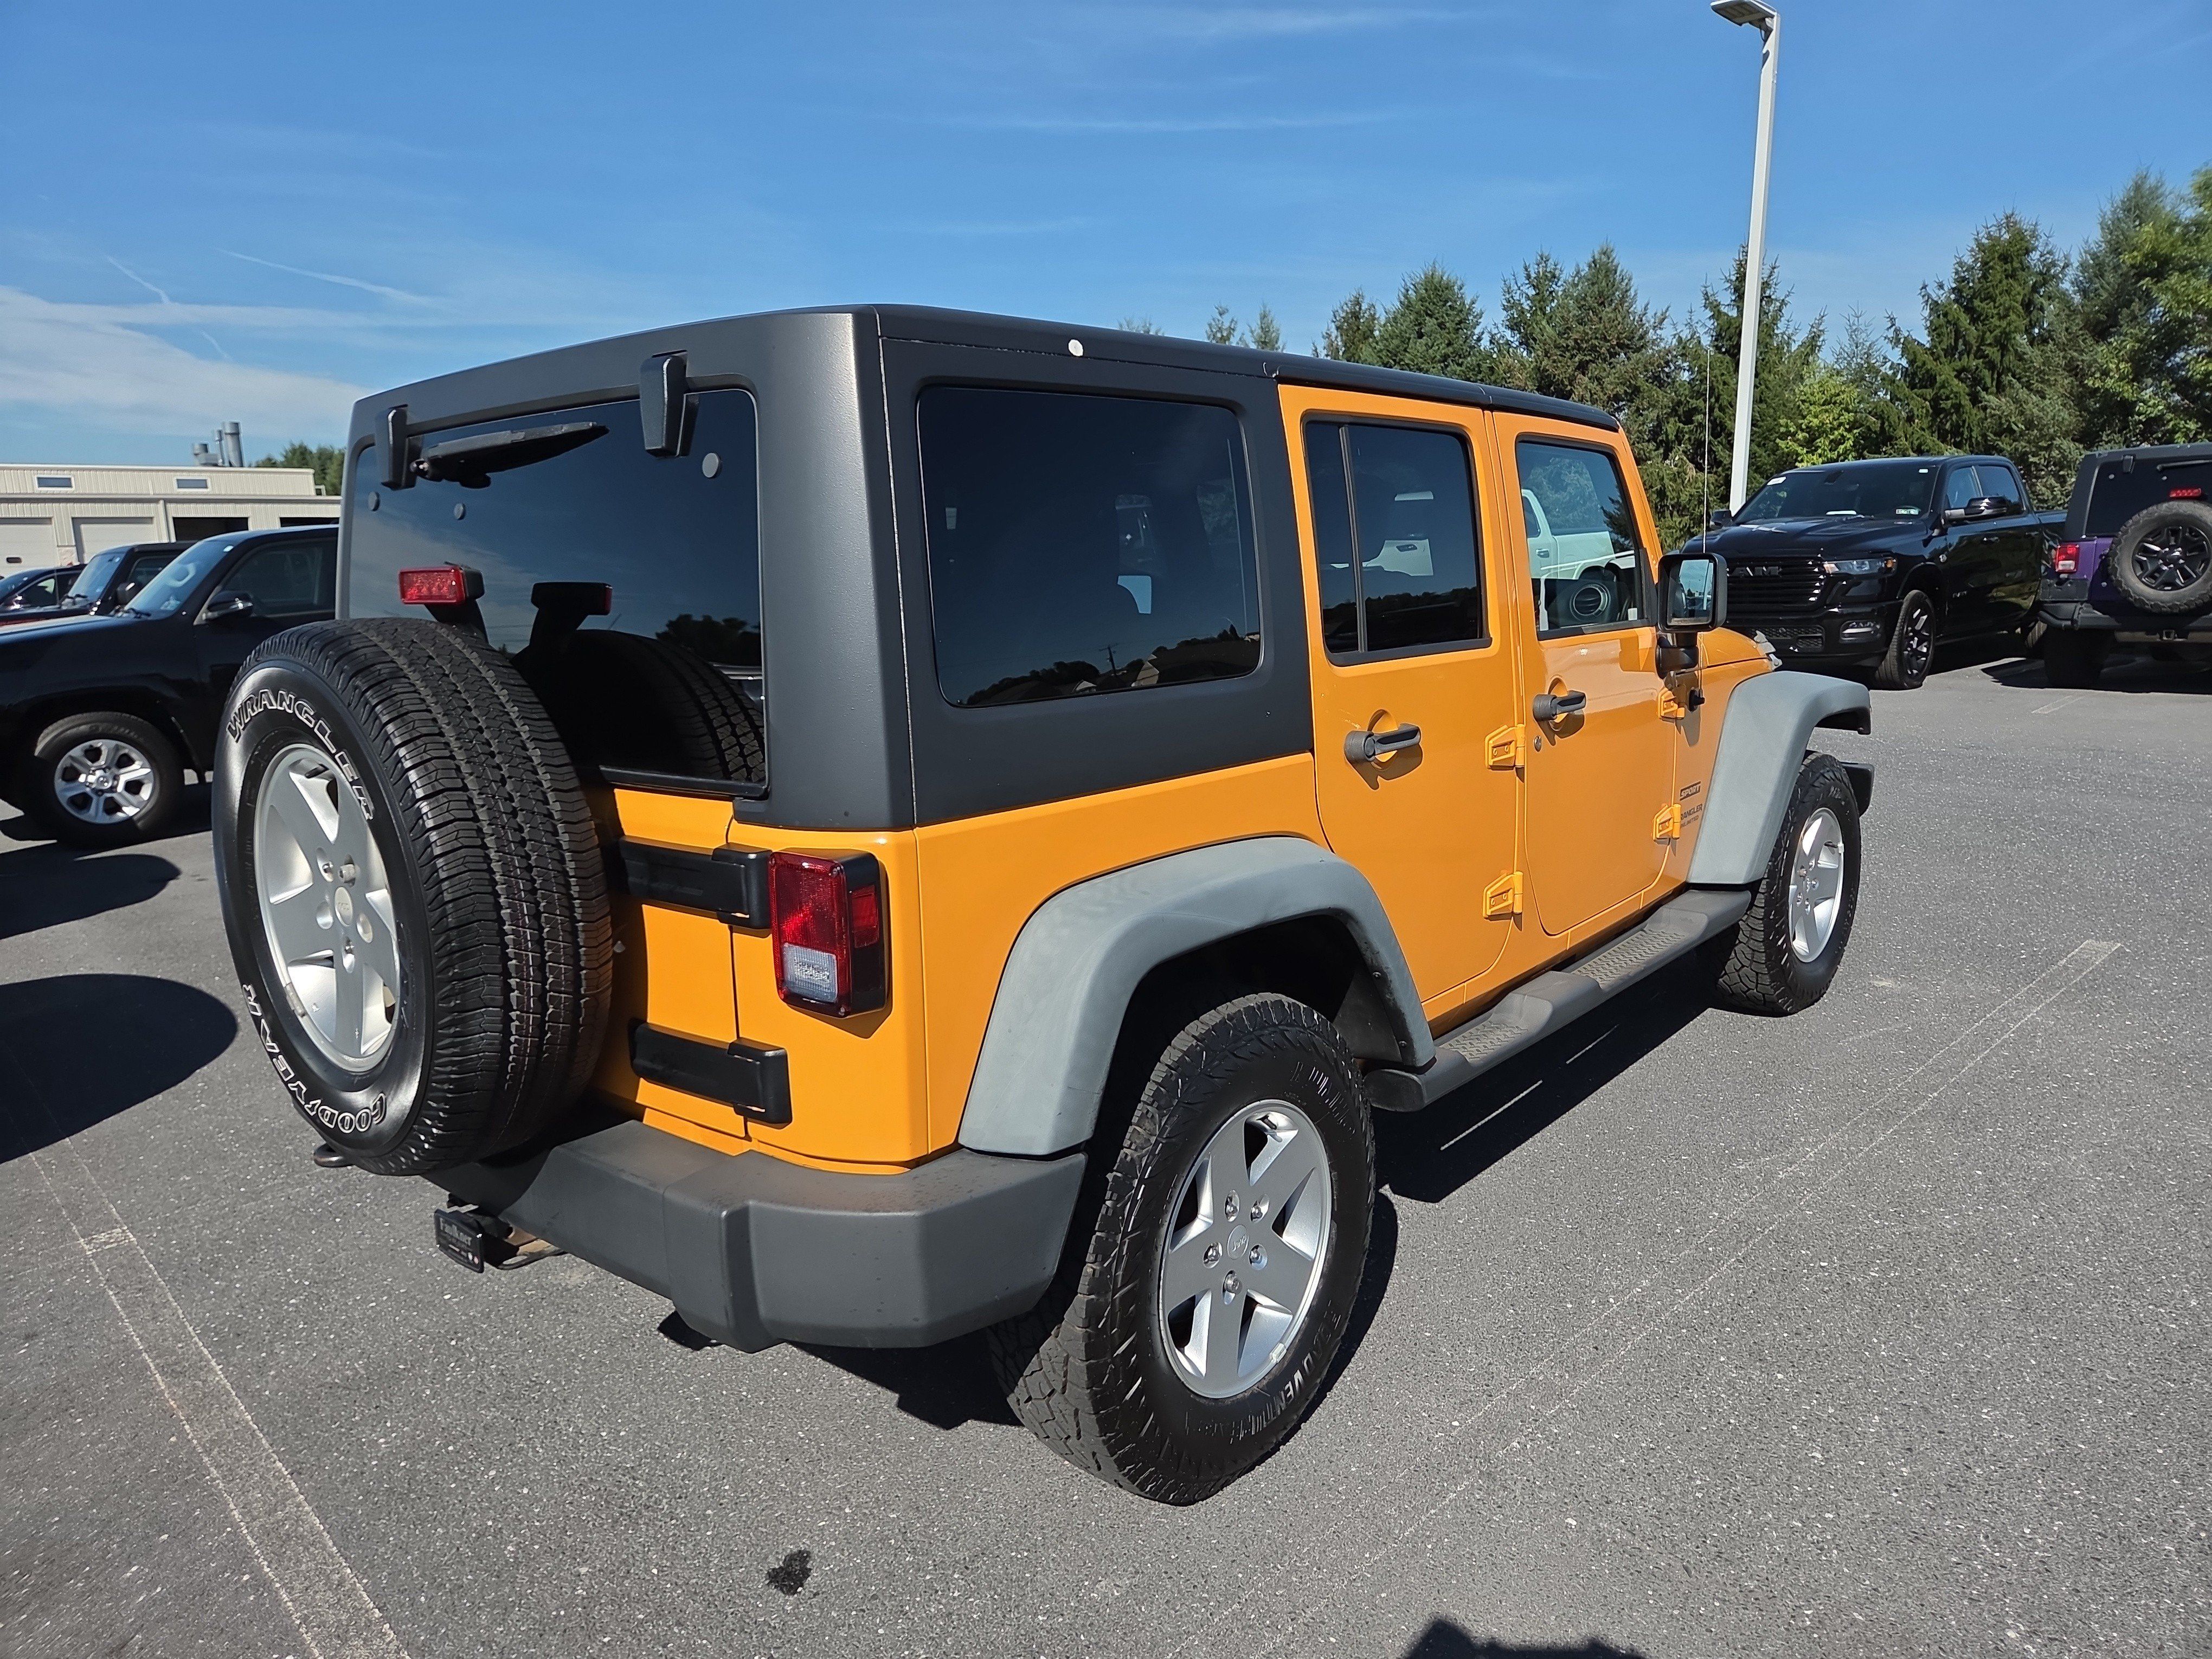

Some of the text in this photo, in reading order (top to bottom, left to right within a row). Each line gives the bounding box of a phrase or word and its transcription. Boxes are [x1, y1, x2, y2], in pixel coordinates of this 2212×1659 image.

[1729, 566, 1780, 577] AM
[226, 689, 375, 820] WRANGLER
[1680, 782, 1701, 799] SPORT
[242, 983, 386, 1134] GOODYEAR
